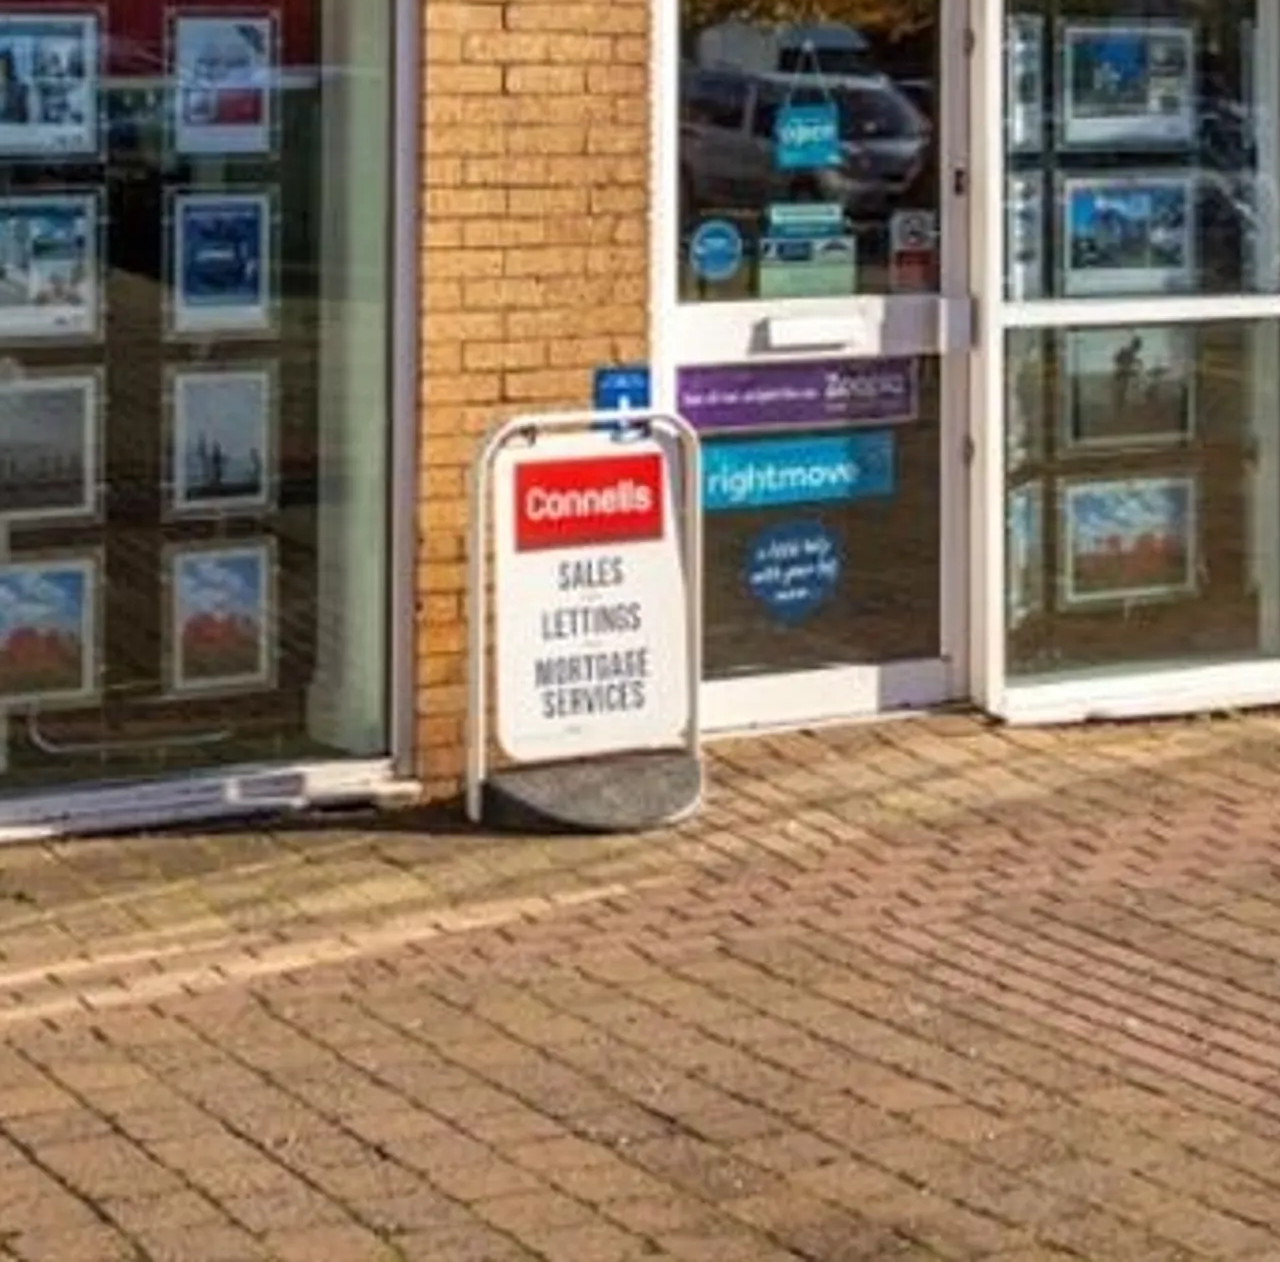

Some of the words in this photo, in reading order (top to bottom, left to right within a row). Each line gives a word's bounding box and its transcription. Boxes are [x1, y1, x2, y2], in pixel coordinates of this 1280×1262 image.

[707, 460, 861, 501] rightmove
[526, 480, 652, 522] Connells
[557, 556, 624, 590] SALES
[541, 602, 642, 640] LETTINGS
[534, 648, 651, 688] MORTGAGE
[541, 681, 647, 719] SERVICES
